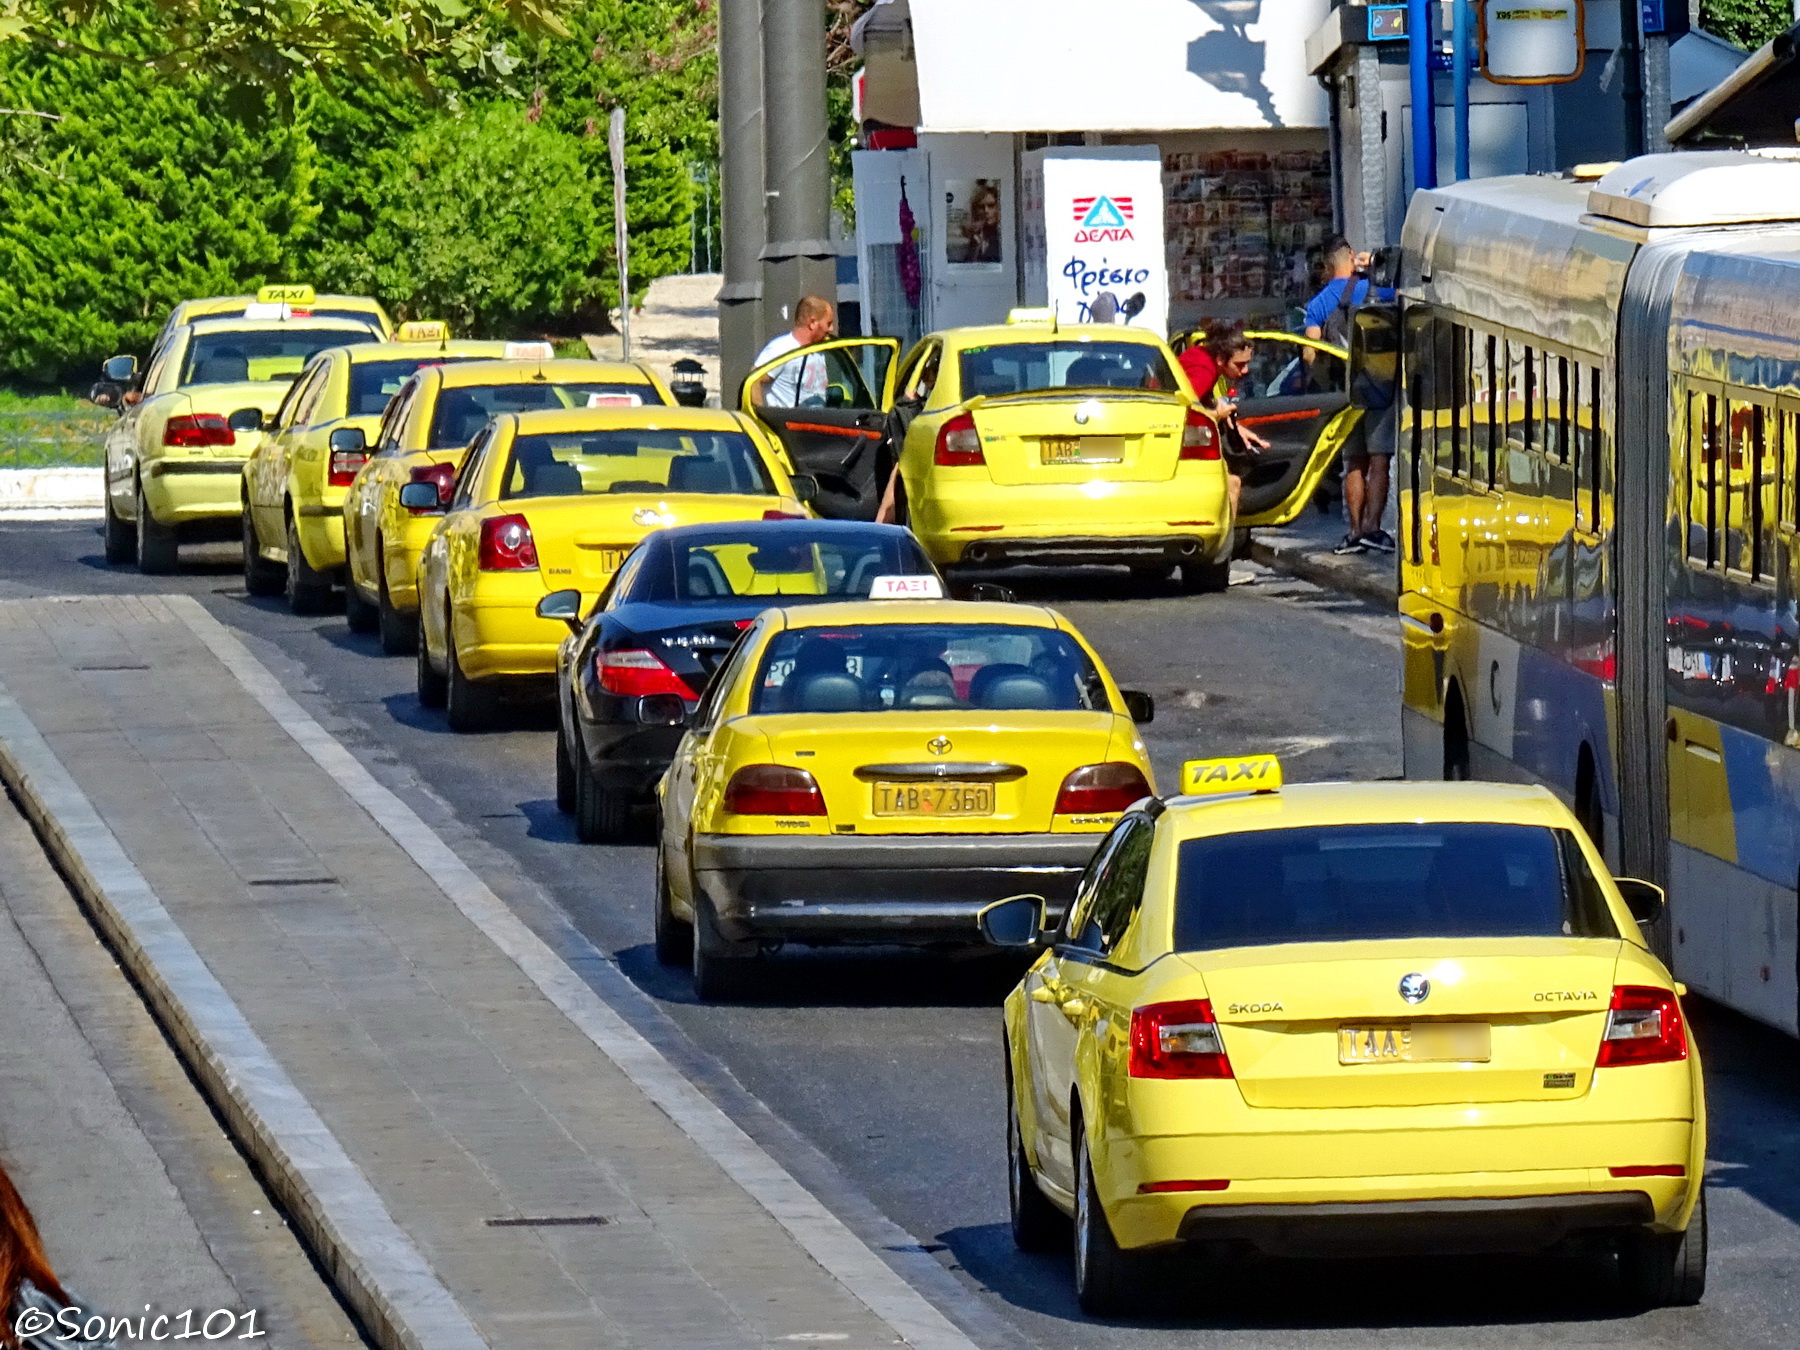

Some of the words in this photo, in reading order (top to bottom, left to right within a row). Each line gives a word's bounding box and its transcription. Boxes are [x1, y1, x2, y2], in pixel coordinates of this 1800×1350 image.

[1074, 228, 1134, 243] ΔΕΛΤΑ
[1063, 255, 1149, 296] Φρέσκο
[267, 290, 305, 300] TAXI
[885, 580, 927, 592] ΤΑΞΙ
[1192, 761, 1271, 784] TAXI
[1533, 991, 1598, 1002] OCTAVIA
[1345, 1029, 1399, 1057] TAA
